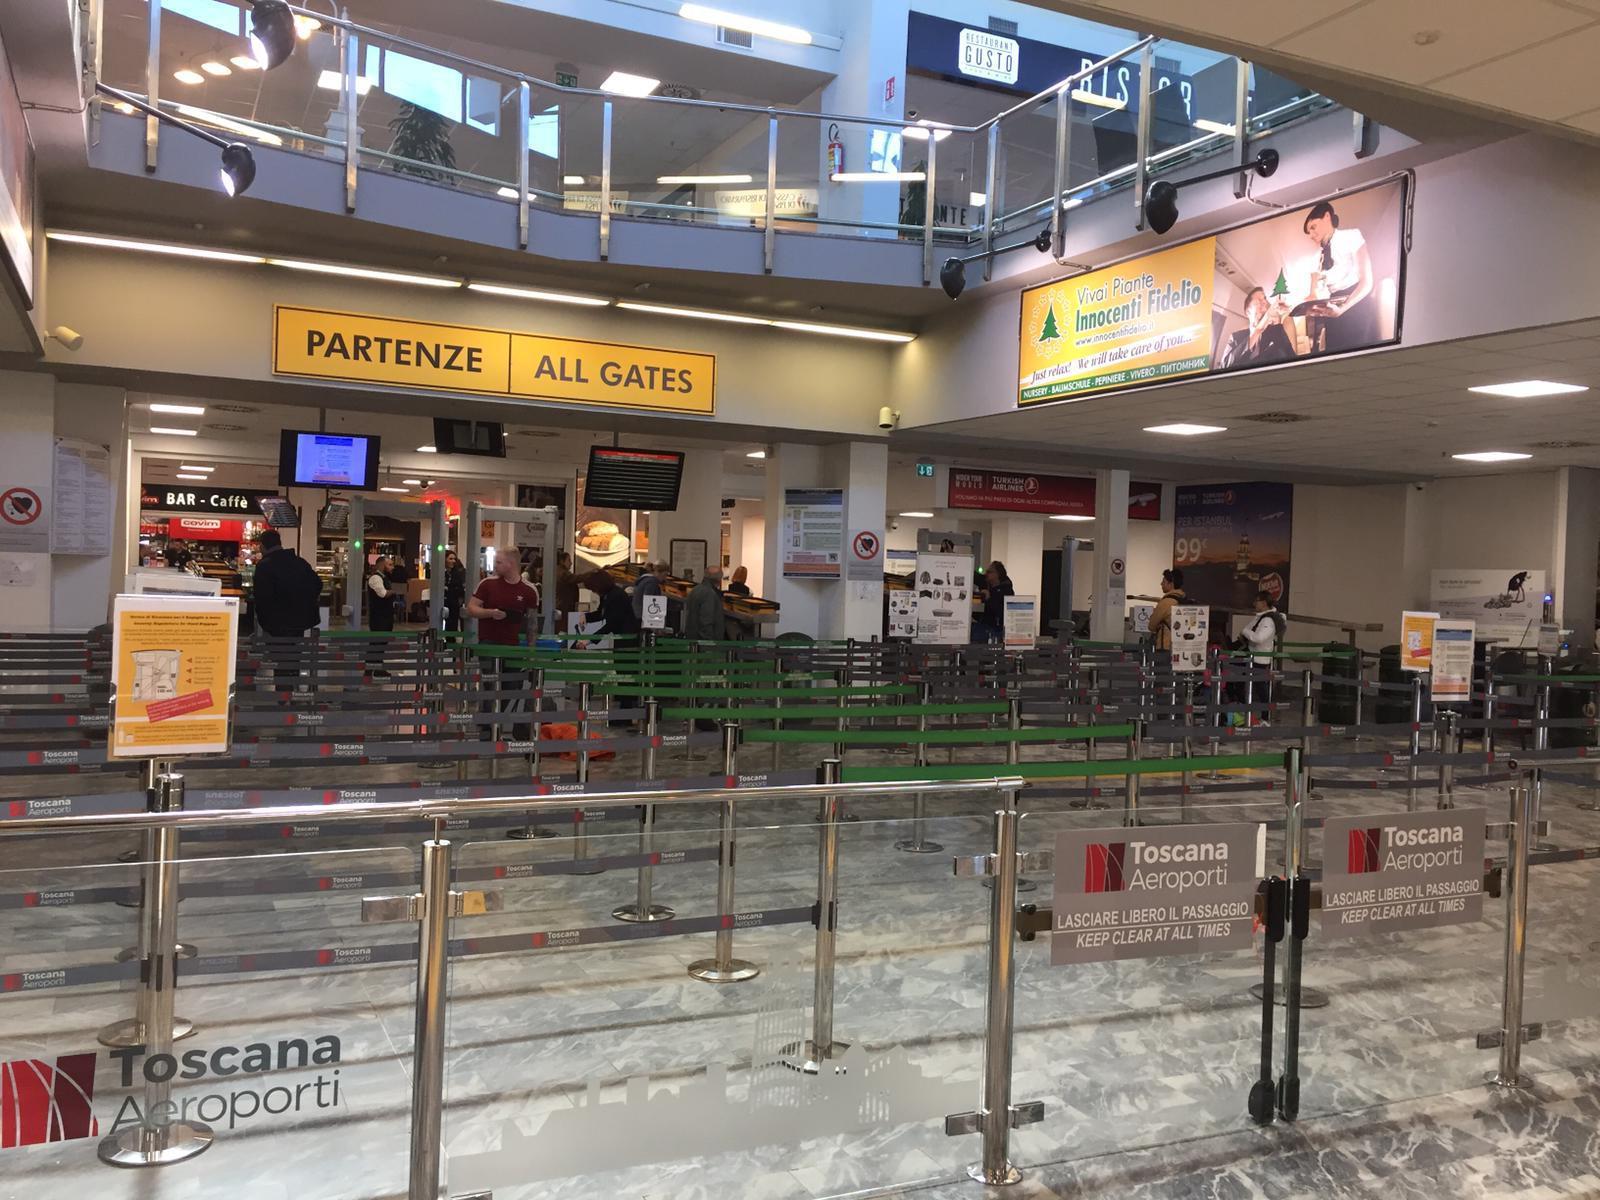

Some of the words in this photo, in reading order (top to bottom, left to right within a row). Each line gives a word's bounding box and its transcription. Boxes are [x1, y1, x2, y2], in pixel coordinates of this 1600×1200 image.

[966, 32, 1013, 50] RESTAURANT
[965, 45, 1013, 73] GUSTO
[1077, 278, 1108, 305] Vivai
[1113, 273, 1154, 297] Piante
[1075, 294, 1141, 332] Innocenti
[1148, 279, 1201, 315] Fidelio
[307, 330, 483, 373] PARTENZE
[1031, 369, 1047, 385] Just
[1048, 362, 1072, 378] relax!
[1077, 358, 1089, 370] We
[1091, 353, 1107, 366] will
[1108, 347, 1129, 362] take
[1131, 344, 1152, 357] care
[1154, 338, 1163, 354] of
[534, 355, 589, 384] ALL
[600, 361, 693, 394] GATES
[1023, 387, 1048, 399] NURSERY
[1052, 380, 1091, 394] BAUMSCHULE
[1095, 373, 1126, 386] PEPINIERE
[1130, 367, 1155, 379] VIVERO
[1160, 357, 1206, 375] ПИТОМНИК
[992, 476, 1024, 484] TURKISH
[992, 484, 1024, 492] AIRLINES
[166, 492, 196, 506] BAR
[210, 494, 248, 509] Caffè
[28, 799, 71, 808] Toscana
[28, 806, 71, 816] Aeroporti
[1384, 825, 1463, 847] Toscana
[1130, 842, 1228, 864] Toscana
[1383, 845, 1463, 872] Aeroporti
[1129, 863, 1228, 893] Aeroporti
[40, 897, 74, 905] Aeroporti
[1326, 890, 1376, 907] LASCIARE
[1378, 886, 1413, 901] LIBERO
[1416, 885, 1424, 898] IL
[1426, 879, 1479, 896] PASSAGGIO
[734, 912, 763, 920] Toscana
[1057, 911, 1119, 929] LASCIARE
[1122, 907, 1166, 924] LIBERO
[1169, 905, 1179, 921] IL
[1182, 902, 1248, 920] PASSAGGIO
[1341, 908, 1369, 924] KEEP
[1370, 906, 1402, 921] CLEAR
[1404, 904, 1416, 917] AT
[1418, 901, 1436, 916] ALL
[1438, 898, 1465, 913] TIMES
[548, 930, 579, 938] Toscana
[1076, 931, 1109, 948] KEEP
[1112, 928, 1152, 945] CLEAR
[1154, 927, 1170, 942] AT
[1171, 925, 1193, 940] ALL
[1197, 922, 1231, 938] TIMES
[334, 948, 371, 956] Toscana
[334, 955, 370, 964] Aeroporti
[23, 970, 65, 980] Toscana
[23, 978, 65, 988] Aeroporti
[109, 1034, 341, 1087] Toscana
[109, 1069, 341, 1135] Aeroporti
